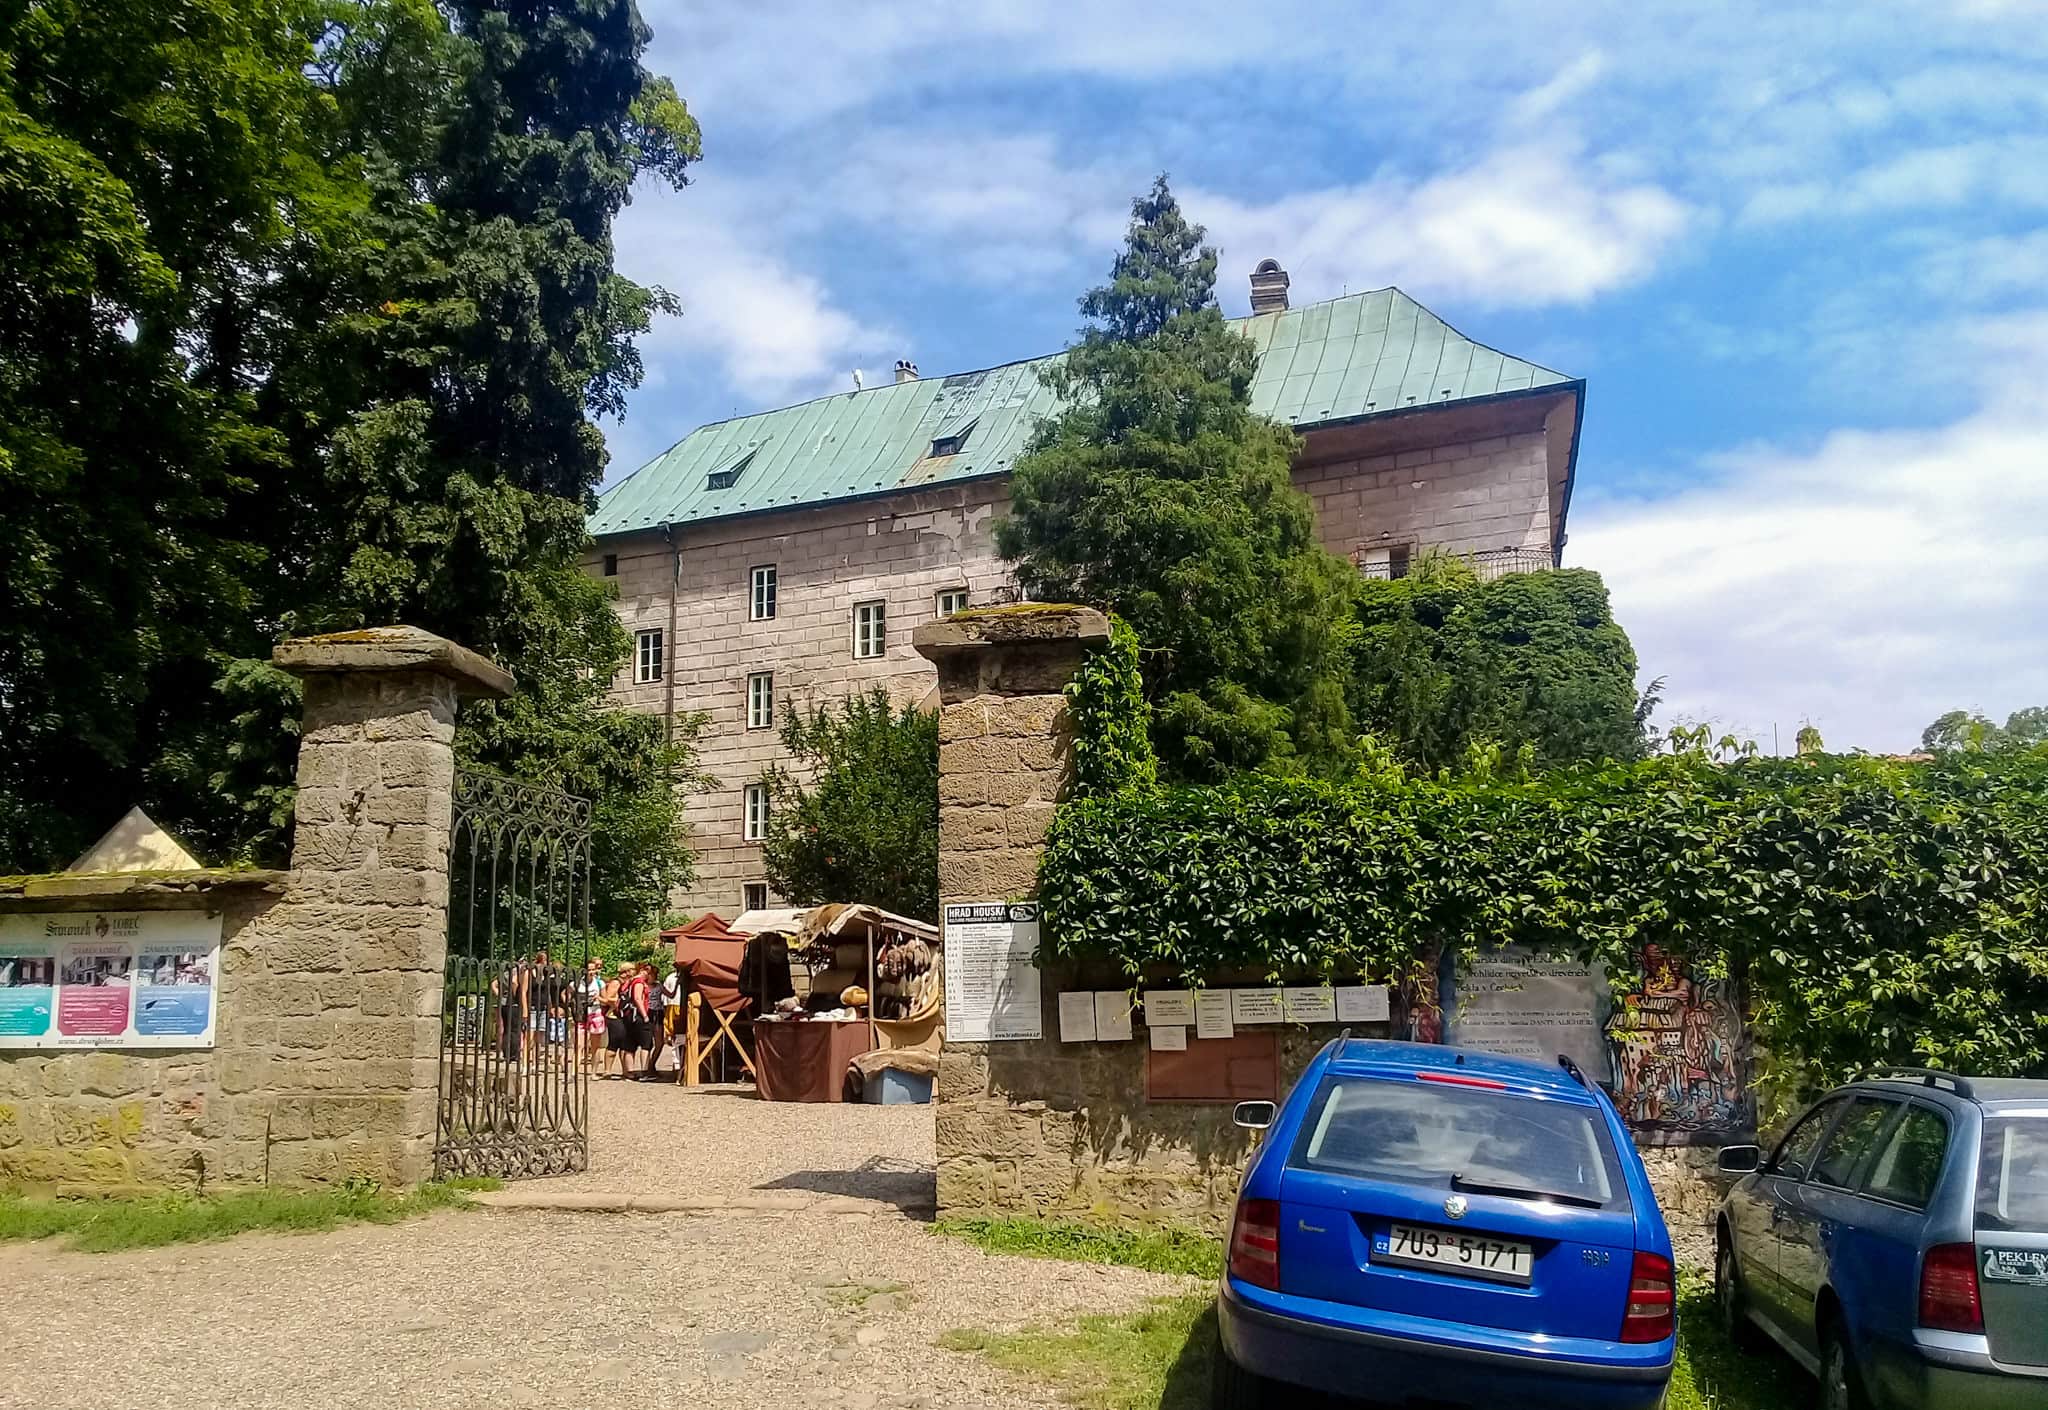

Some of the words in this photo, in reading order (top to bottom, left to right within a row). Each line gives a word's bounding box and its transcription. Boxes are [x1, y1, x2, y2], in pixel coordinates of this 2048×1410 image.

[948, 907, 971, 918] HRAD
[973, 906, 1006, 917] HOUSKA
[1376, 1241, 1388, 1250] CZ
[1396, 1228, 1439, 1257] 7U3
[1459, 1238, 1518, 1271] 5171
